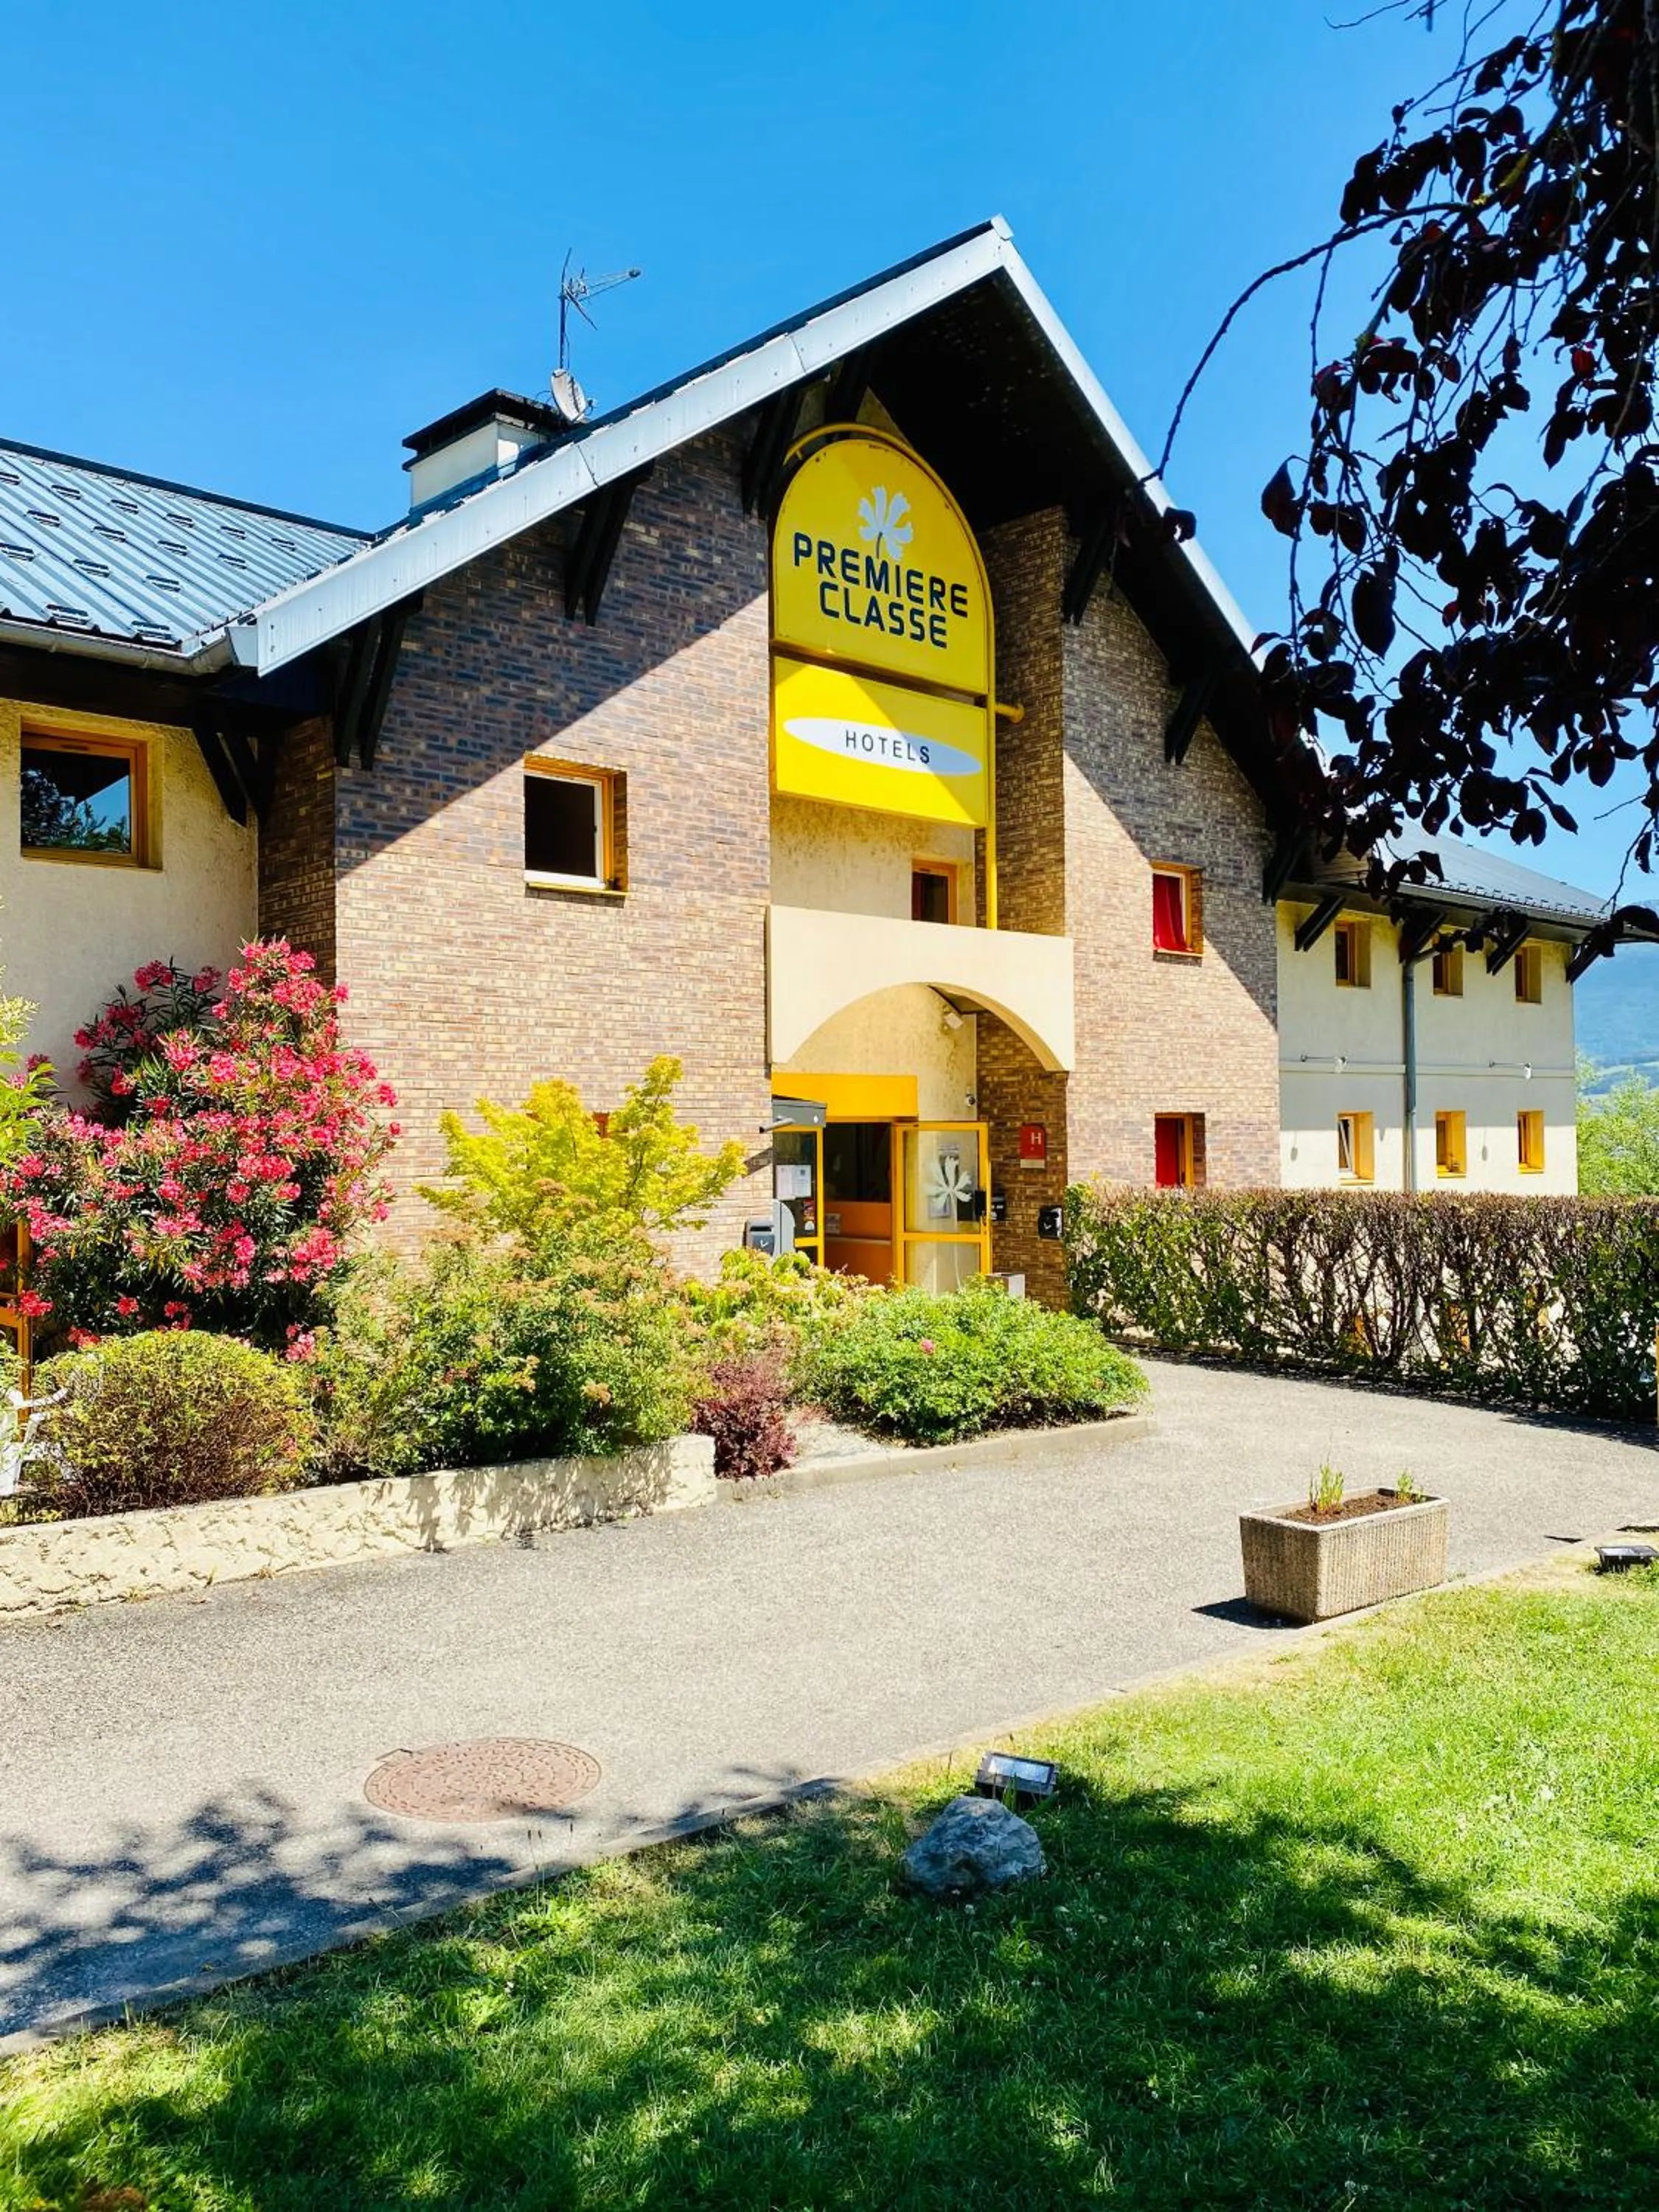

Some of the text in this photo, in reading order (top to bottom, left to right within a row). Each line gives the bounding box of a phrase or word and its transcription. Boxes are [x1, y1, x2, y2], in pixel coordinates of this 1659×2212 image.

[793, 532, 968, 619] PREMIERE
[819, 581, 947, 649] CLASSE
[846, 729, 931, 765] HOTELS
[1031, 1132, 1042, 1145] H
